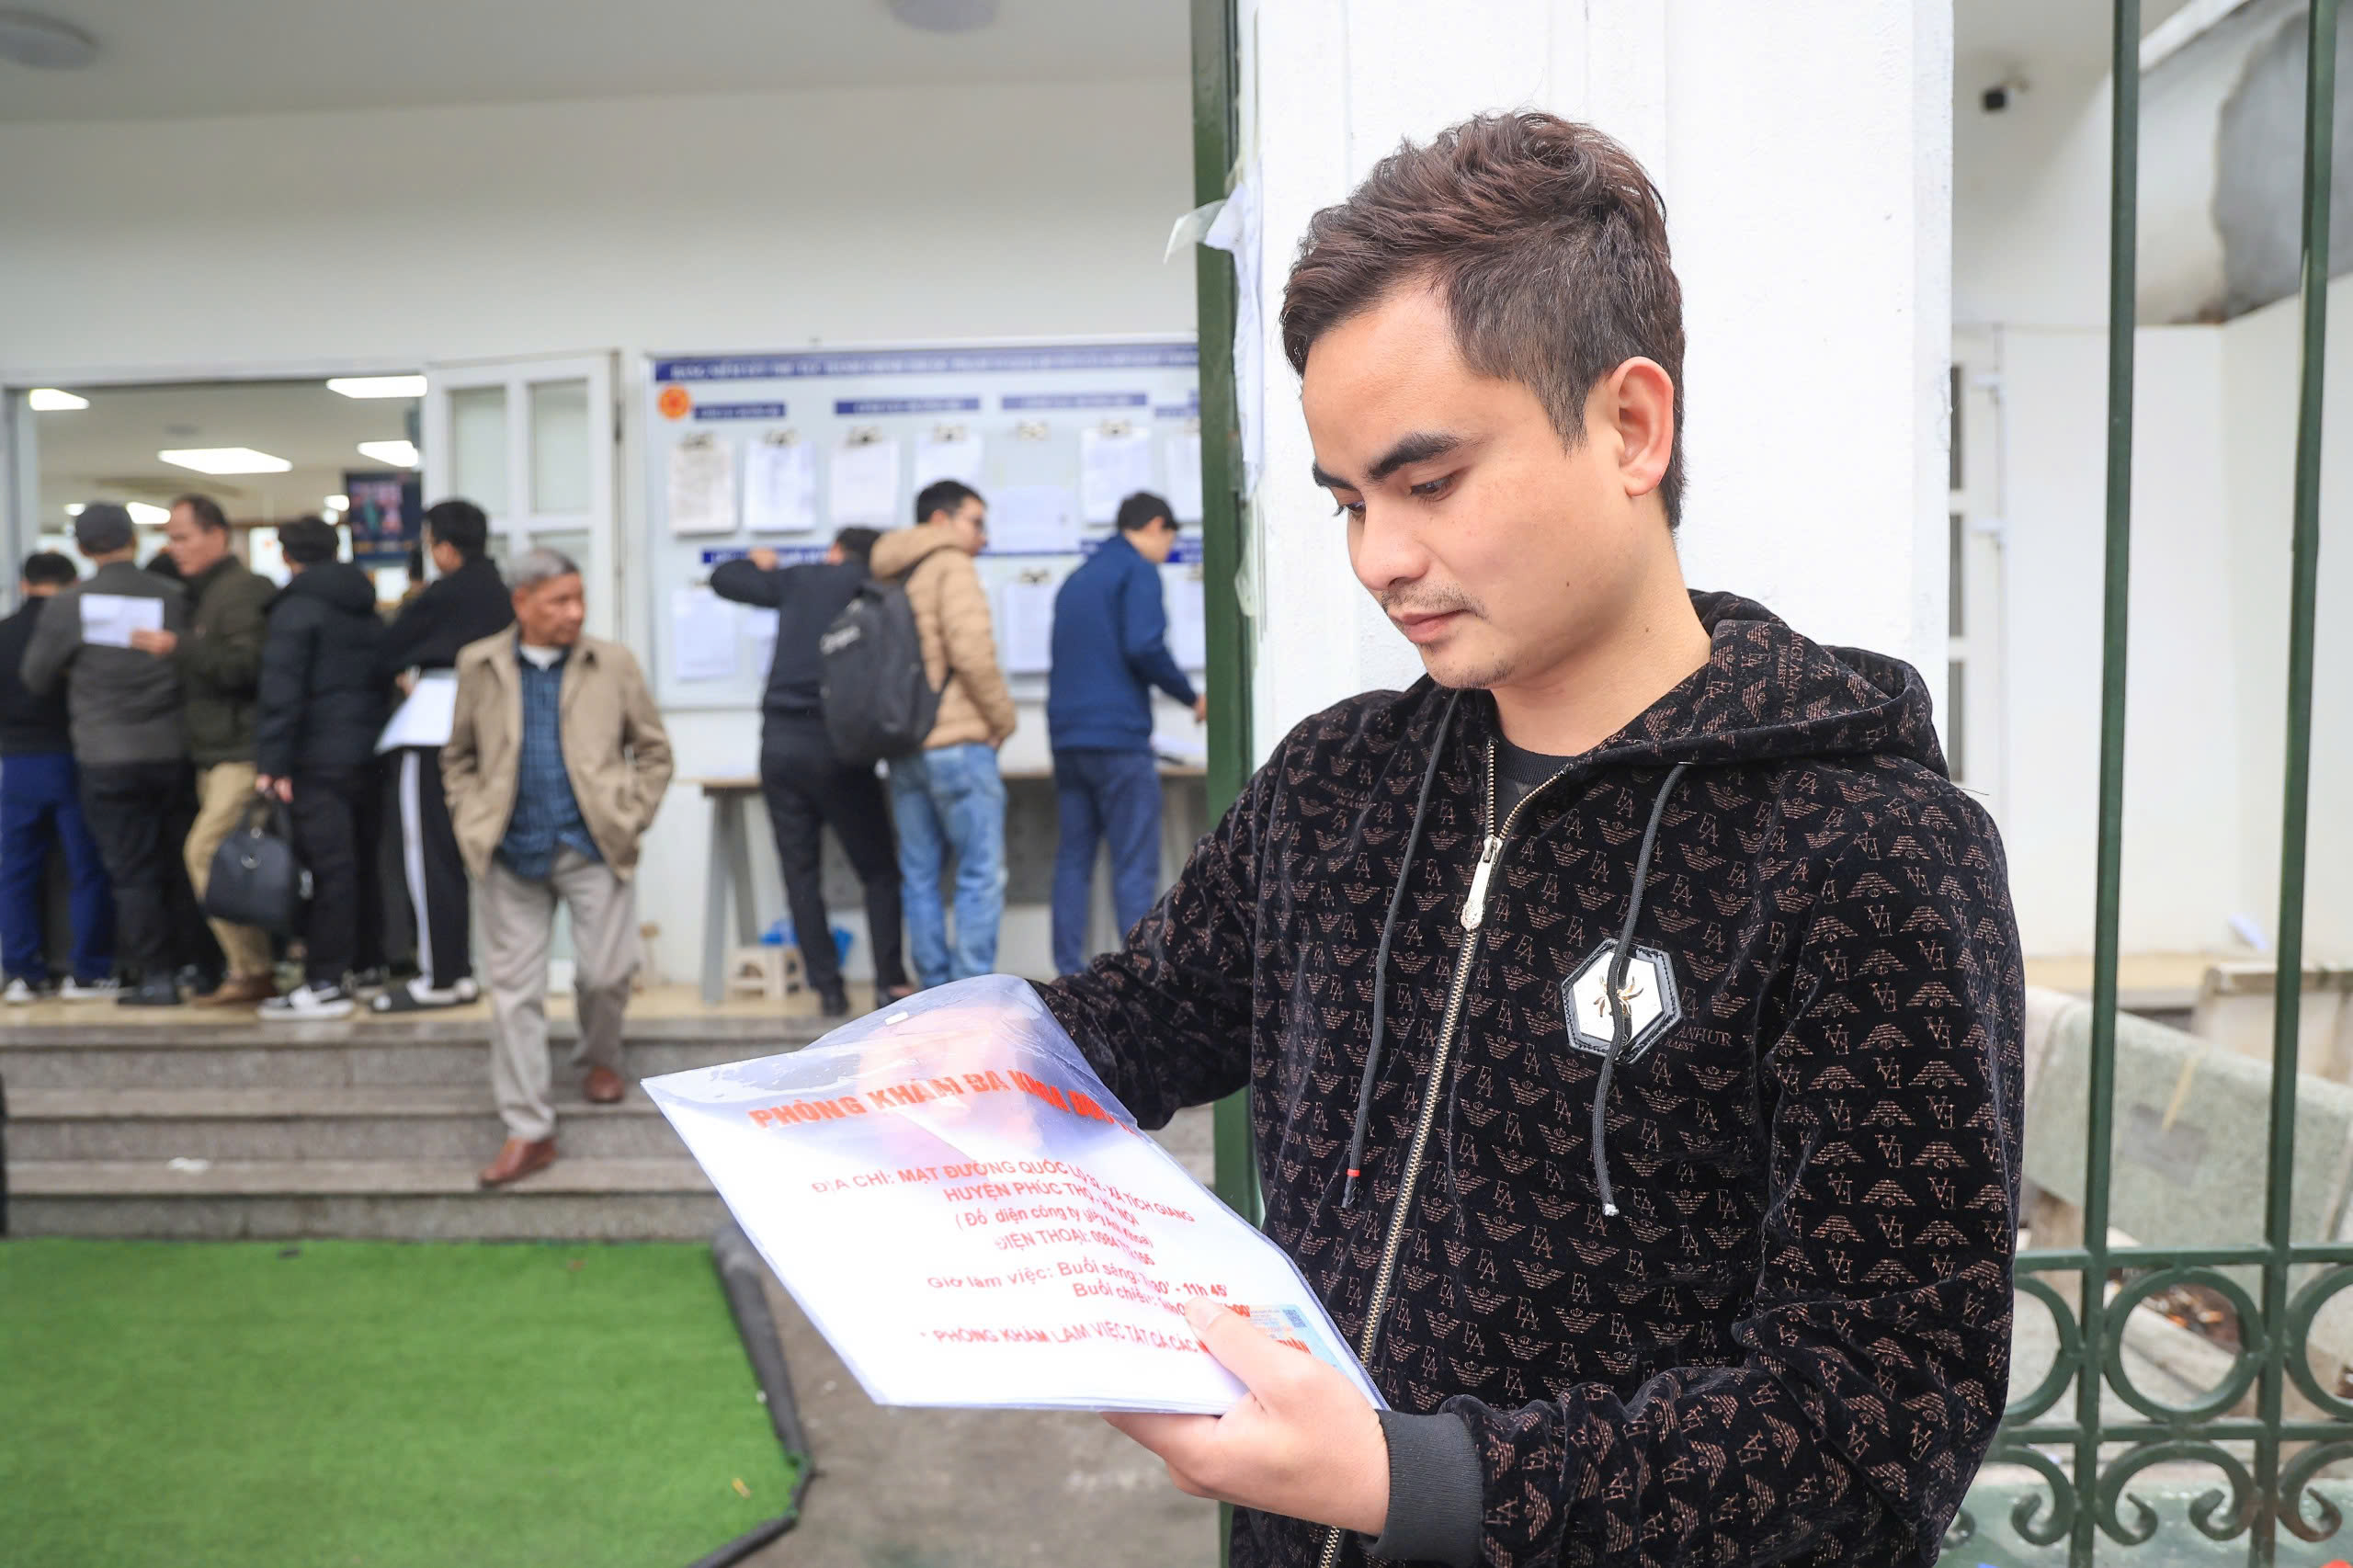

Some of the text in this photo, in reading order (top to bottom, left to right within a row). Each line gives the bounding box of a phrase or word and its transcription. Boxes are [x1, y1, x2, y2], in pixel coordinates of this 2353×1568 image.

[748, 1099, 868, 1130] PHÒNG
[942, 1160, 1017, 1178] ĐƯỜNG
[1018, 1158, 1068, 1175] QUỐC
[1154, 1203, 1195, 1221] GIANG
[943, 1181, 1012, 1202] HUYỆN
[1013, 1179, 1063, 1196] PHÚC
[995, 1207, 1029, 1224] diện
[1030, 1205, 1067, 1221] công
[1067, 1206, 1080, 1222] ty
